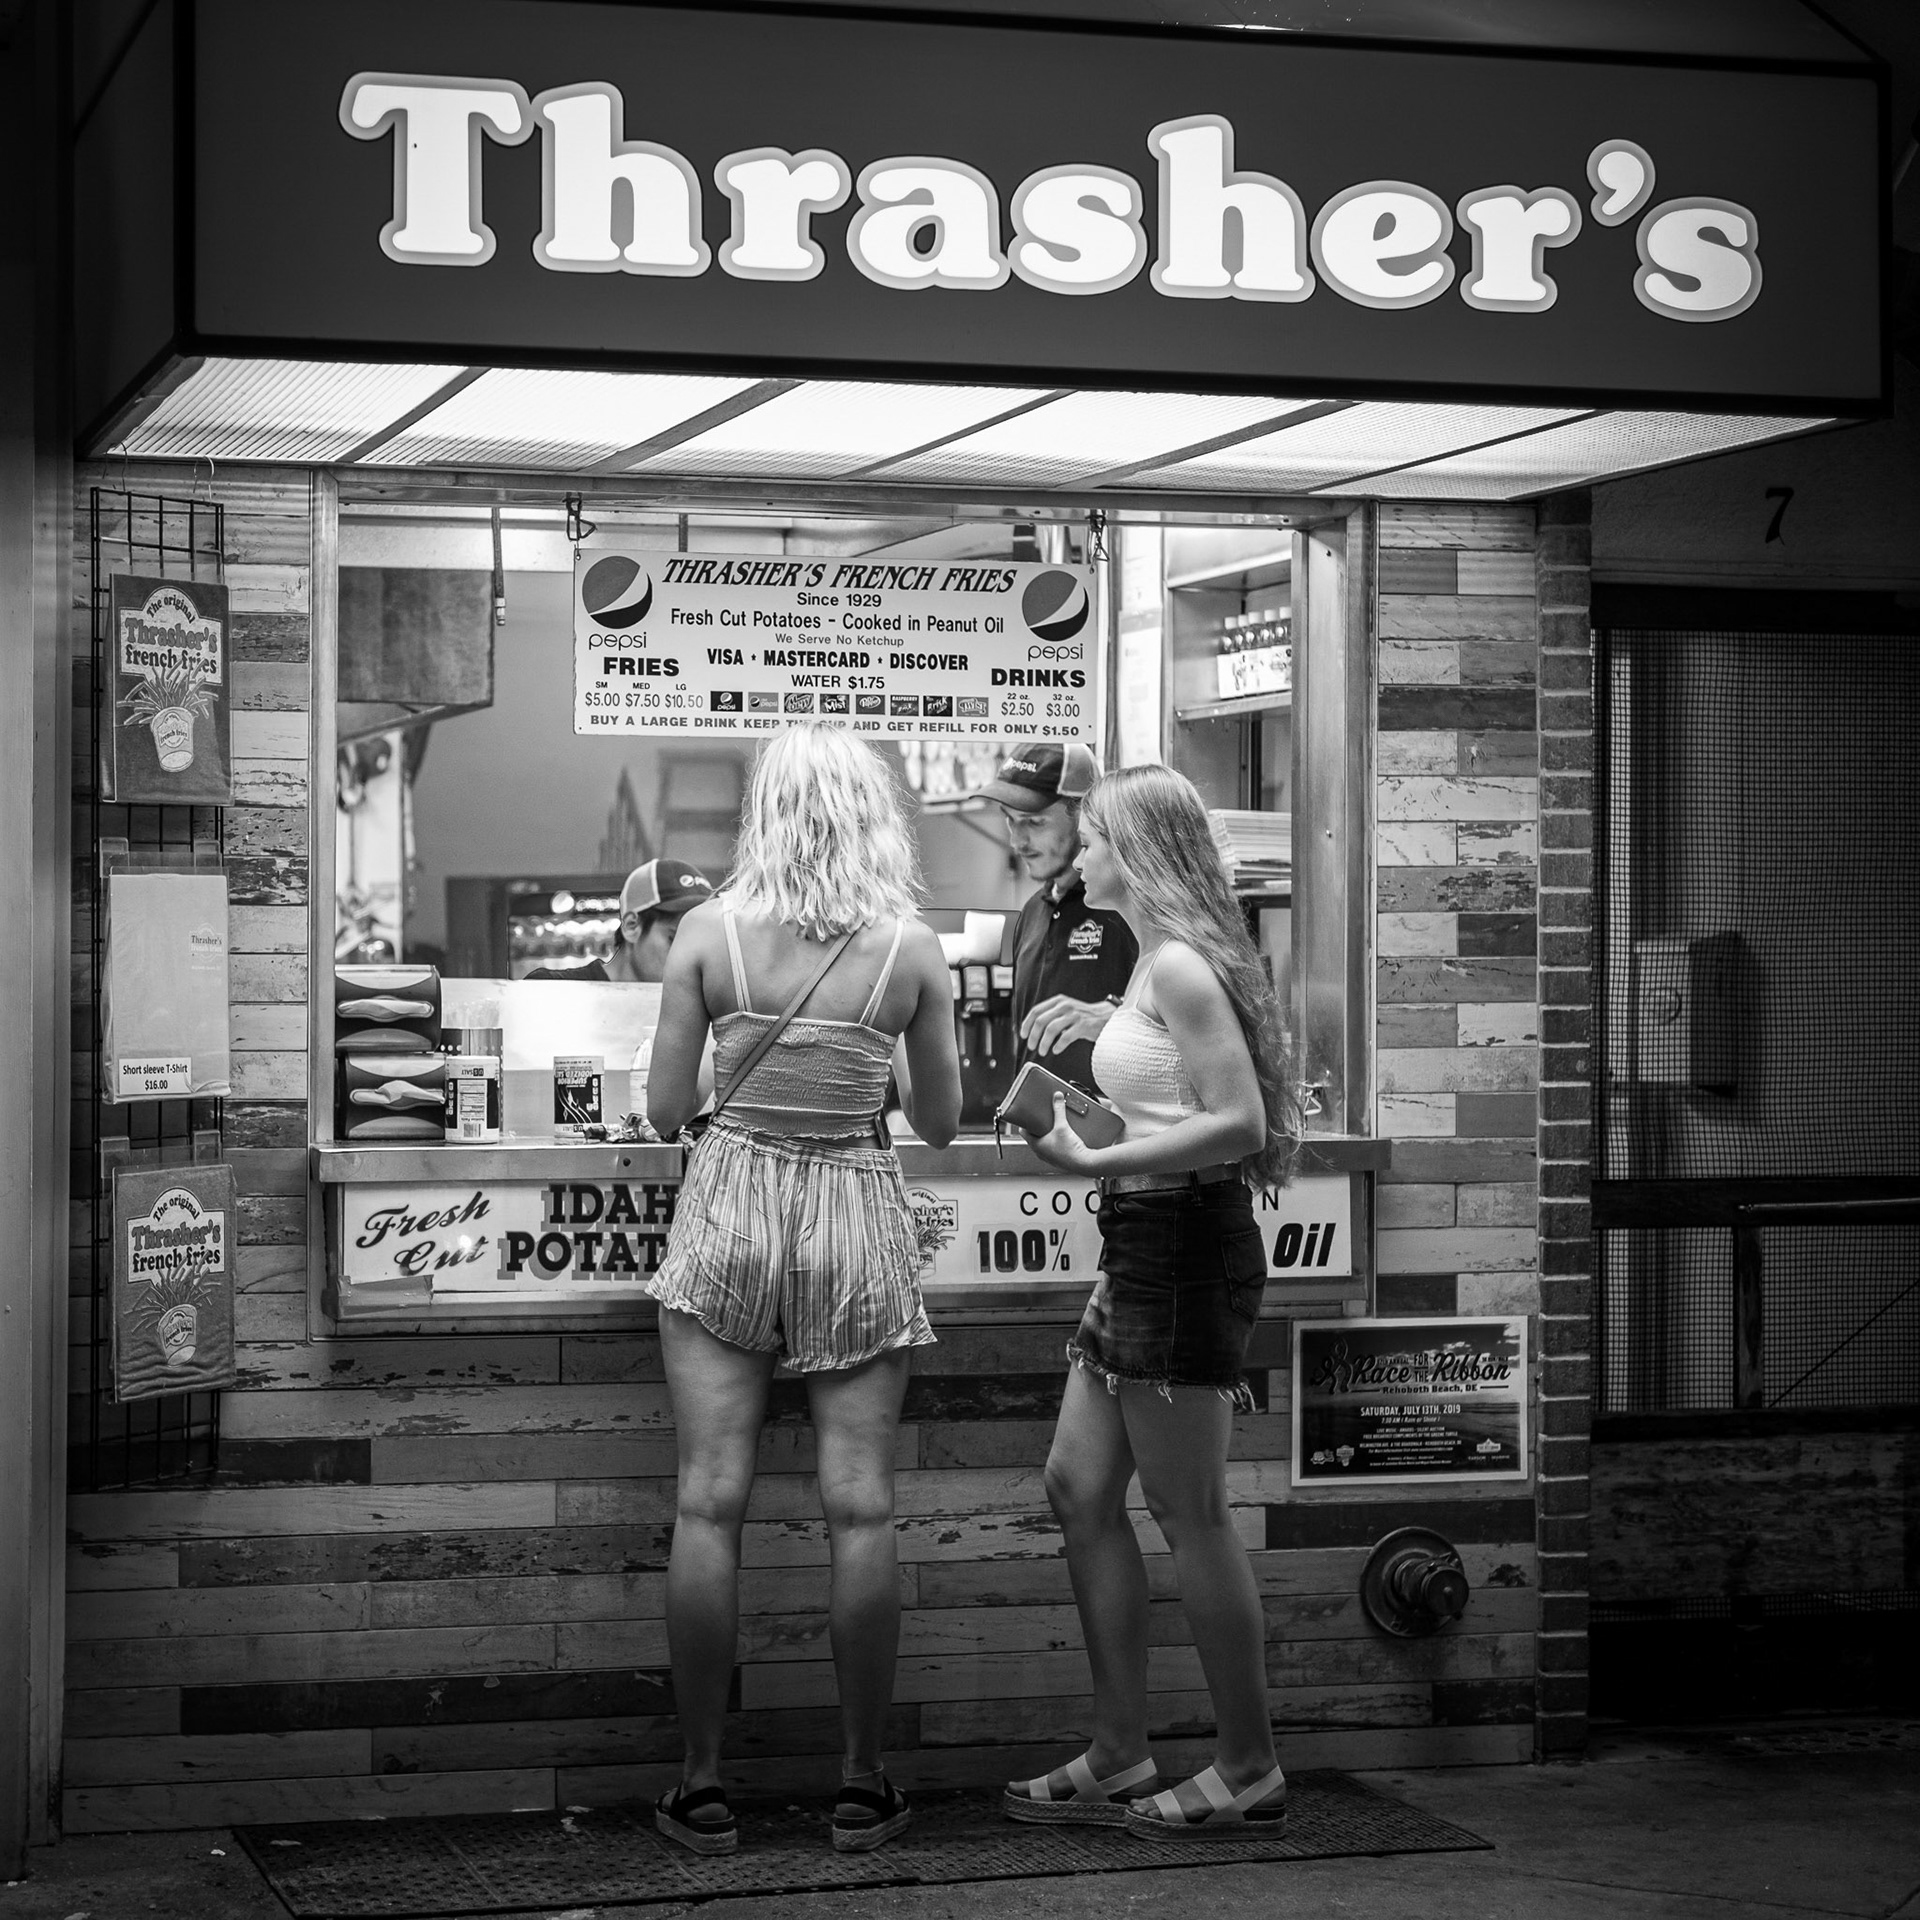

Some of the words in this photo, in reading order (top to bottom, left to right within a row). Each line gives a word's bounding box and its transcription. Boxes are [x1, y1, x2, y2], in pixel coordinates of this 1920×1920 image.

[339, 71, 1762, 323] Thrasher's
[1765, 486, 1794, 545] 7
[662, 558, 827, 588] THRASHER'S
[829, 563, 938, 591] FRENCH
[939, 567, 1018, 593] FRIES
[147, 600, 162, 618] The
[164, 595, 195, 624] original
[797, 592, 839, 606] Since
[845, 593, 882, 607] 1929
[671, 608, 713, 626] Fresh
[720, 609, 746, 627] Cut
[753, 610, 821, 628] Potatoes
[843, 613, 901, 630] Cooked
[908, 614, 920, 631] in
[927, 615, 978, 632] Peanut
[984, 616, 1004, 633] Oil
[125, 617, 217, 653] Thrasher's
[588, 631, 647, 651] pepsi
[775, 633, 793, 644] We
[798, 633, 831, 645] Serve
[836, 635, 852, 645] No
[857, 635, 904, 648] Ketchup
[126, 644, 177, 669] french
[182, 650, 217, 674] fries
[707, 648, 744, 665] VISA
[763, 650, 870, 668] MASTERCARD
[889, 653, 968, 671] DISCOVER
[1027, 643, 1084, 663] pepsi
[603, 656, 680, 677] FRIES
[991, 668, 1086, 688] DRINKS
[595, 681, 608, 689] SM
[632, 682, 651, 690] MED
[675, 683, 687, 691] LG
[791, 674, 841, 688] WATER
[848, 676, 885, 690] $1.75
[585, 692, 620, 708] $5.00
[625, 692, 660, 708] $7.50
[1001, 702, 1034, 717] $2.50
[1046, 703, 1080, 718] $3.00
[590, 715, 619, 726] BUY
[625, 716, 636, 726] A
[641, 716, 688, 727] LARGE
[694, 717, 738, 728] DRINK
[743, 719, 780, 729] KEEP
[853, 721, 881, 731] AND
[887, 721, 913, 732] GET
[919, 722, 965, 733] REFILL
[970, 723, 997, 734] FOR
[1004, 724, 1038, 735] ONLY
[1042, 725, 1080, 736] $1.50
[191, 935, 222, 945] Thrasher's
[123, 1065, 142, 1075] Short
[143, 1064, 165, 1075] sleeve
[166, 1063, 188, 1074] T-Shirt
[145, 1080, 168, 1091] $16.00
[153, 1202, 168, 1222] The
[169, 1194, 200, 1220] original
[355, 1190, 492, 1249] Fresh
[544, 1184, 680, 1230] IDAH
[132, 1219, 221, 1251] Thrasher's
[1273, 1222, 1336, 1268] Oil
[133, 1248, 182, 1273] french
[186, 1245, 220, 1266] fries
[393, 1235, 490, 1276] Cut
[500, 1231, 667, 1278] POTAT
[977, 1228, 1070, 1274] 100%
[1350, 1353, 1412, 1385] Race
[1413, 1353, 1428, 1366] FOR
[1414, 1370, 1429, 1383] THE
[1431, 1353, 1511, 1383] Ribbon
[1382, 1385, 1430, 1395] Rehoboth
[1432, 1384, 1463, 1394] Beach,
[1466, 1384, 1478, 1392] DE
[1360, 1406, 1401, 1417] SATURDAY,
[1402, 1405, 1420, 1416] JULY
[1422, 1405, 1442, 1415] 13TH,
[1443, 1404, 1461, 1414] 2019
